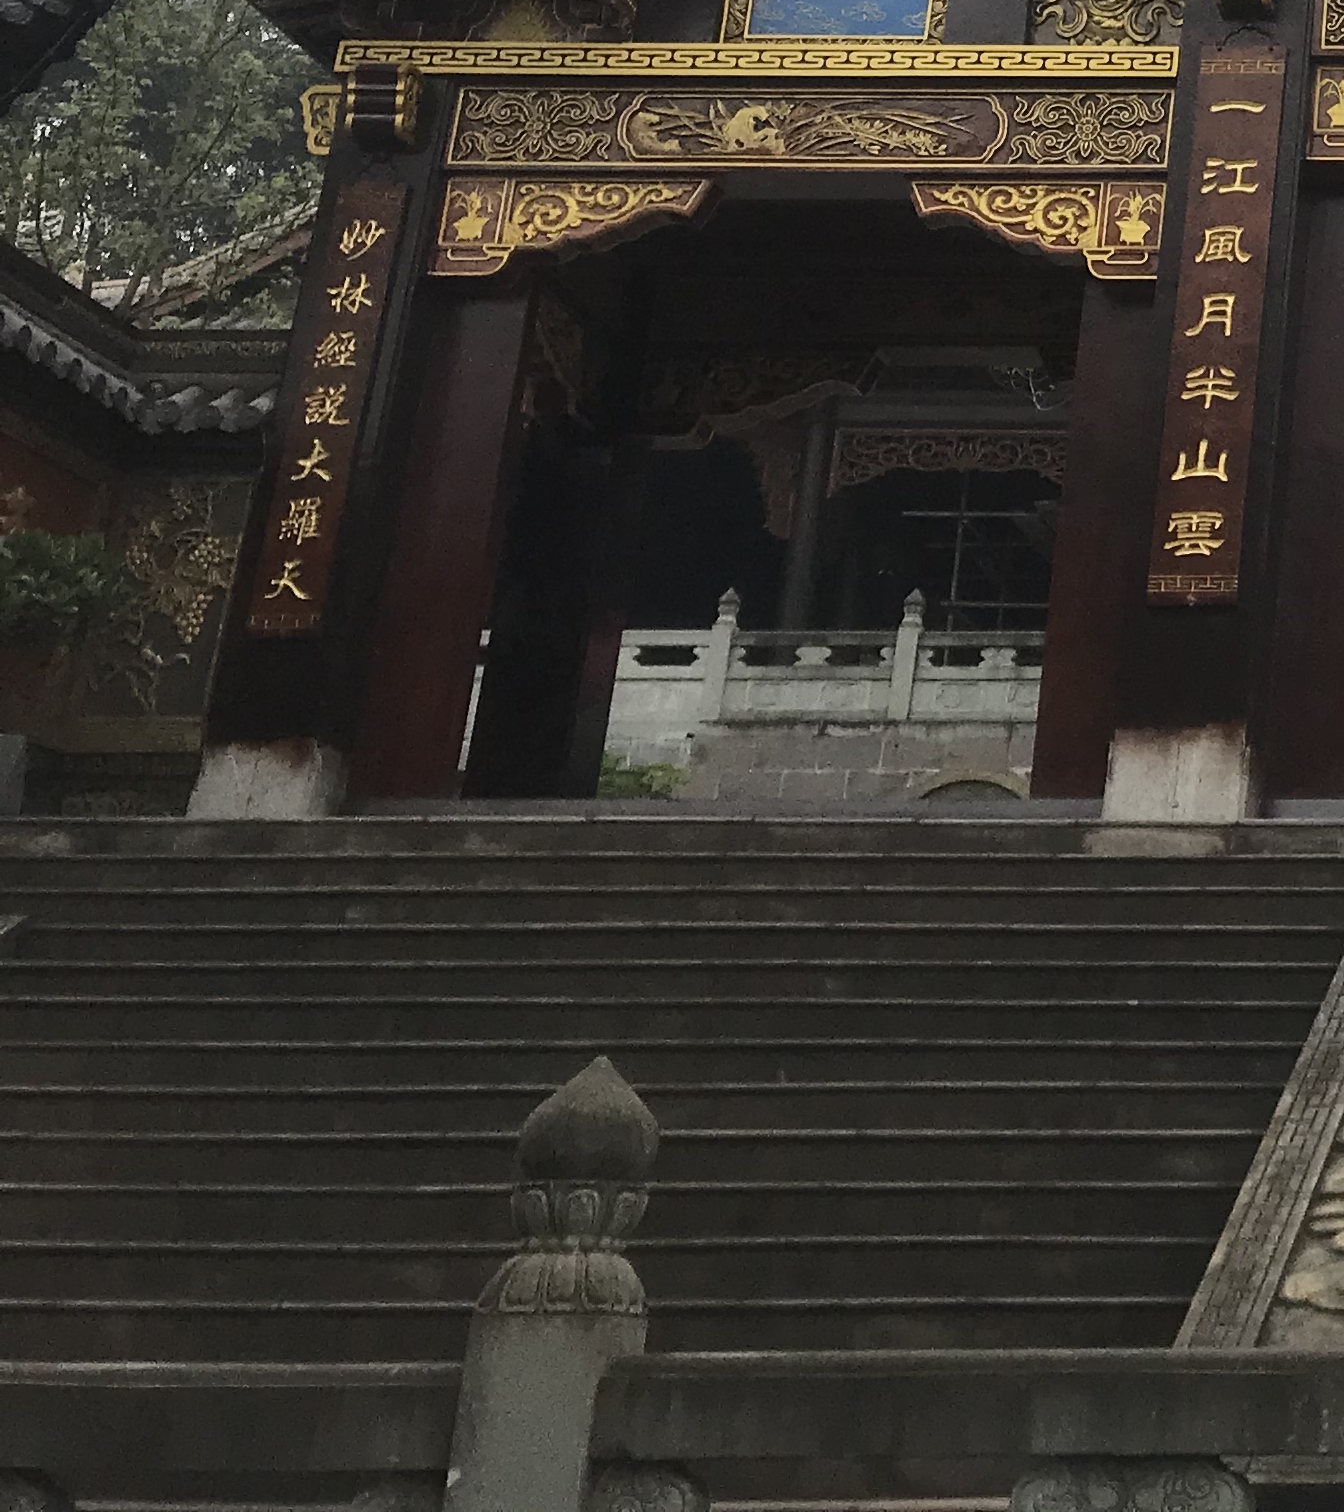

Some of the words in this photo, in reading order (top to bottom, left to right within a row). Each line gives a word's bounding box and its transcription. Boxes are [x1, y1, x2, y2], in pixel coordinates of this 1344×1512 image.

[1162, 97, 1268, 558] 一江風月半山雲
